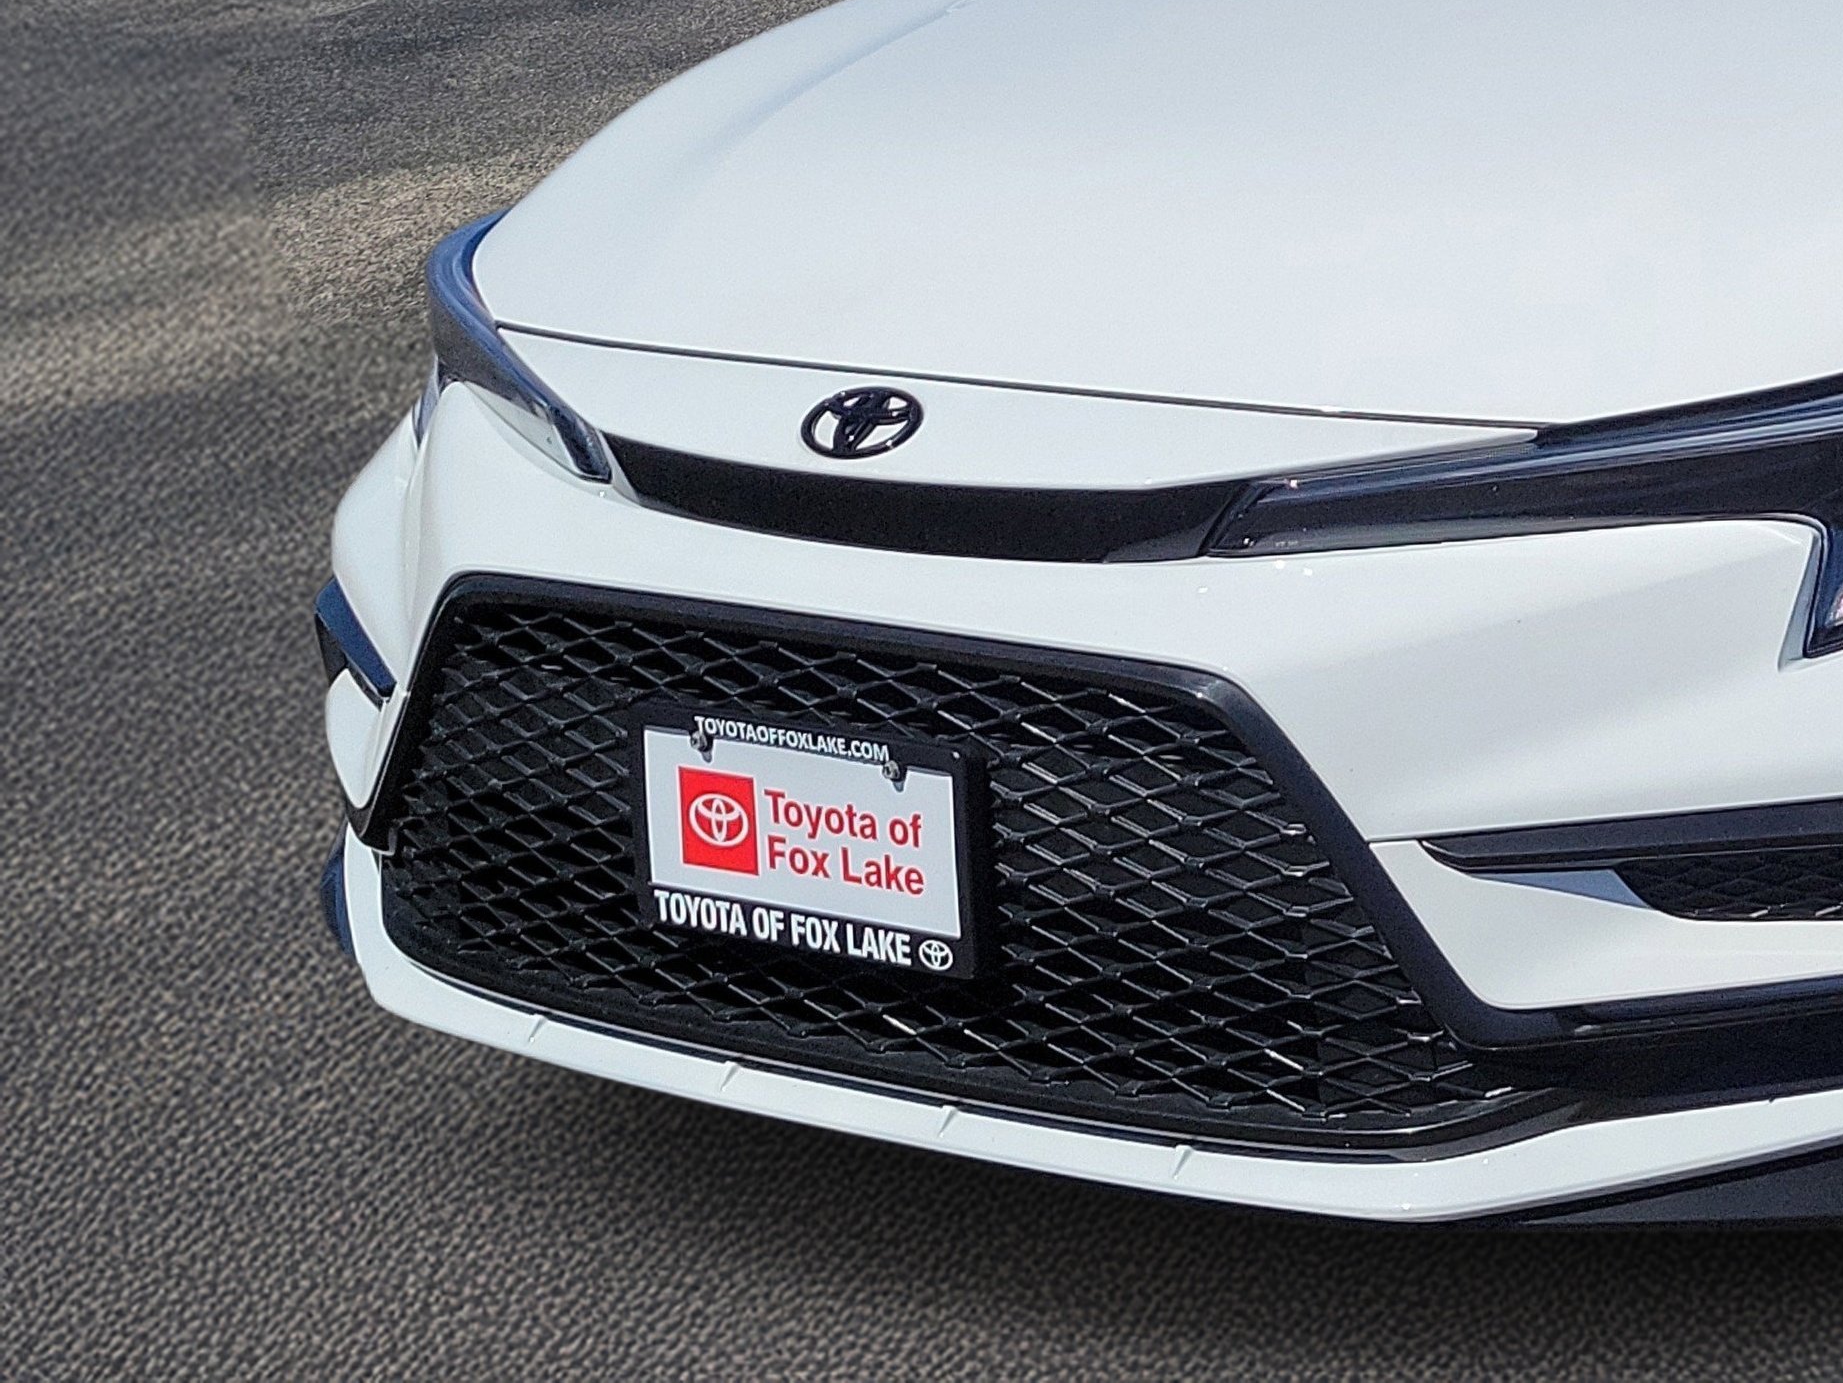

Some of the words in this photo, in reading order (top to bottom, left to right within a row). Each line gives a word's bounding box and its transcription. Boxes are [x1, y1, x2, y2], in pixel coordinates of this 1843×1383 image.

[694, 716, 889, 761] TOYOTAOFFOXLAKE.COM
[764, 788, 877, 841] Toyota
[888, 814, 922, 848] of
[766, 835, 831, 879] Fox
[841, 846, 925, 896] Lake
[653, 889, 747, 936] TOYOTA
[753, 907, 784, 941] OF
[791, 913, 841, 954] FOX
[846, 924, 912, 966] LAKE
